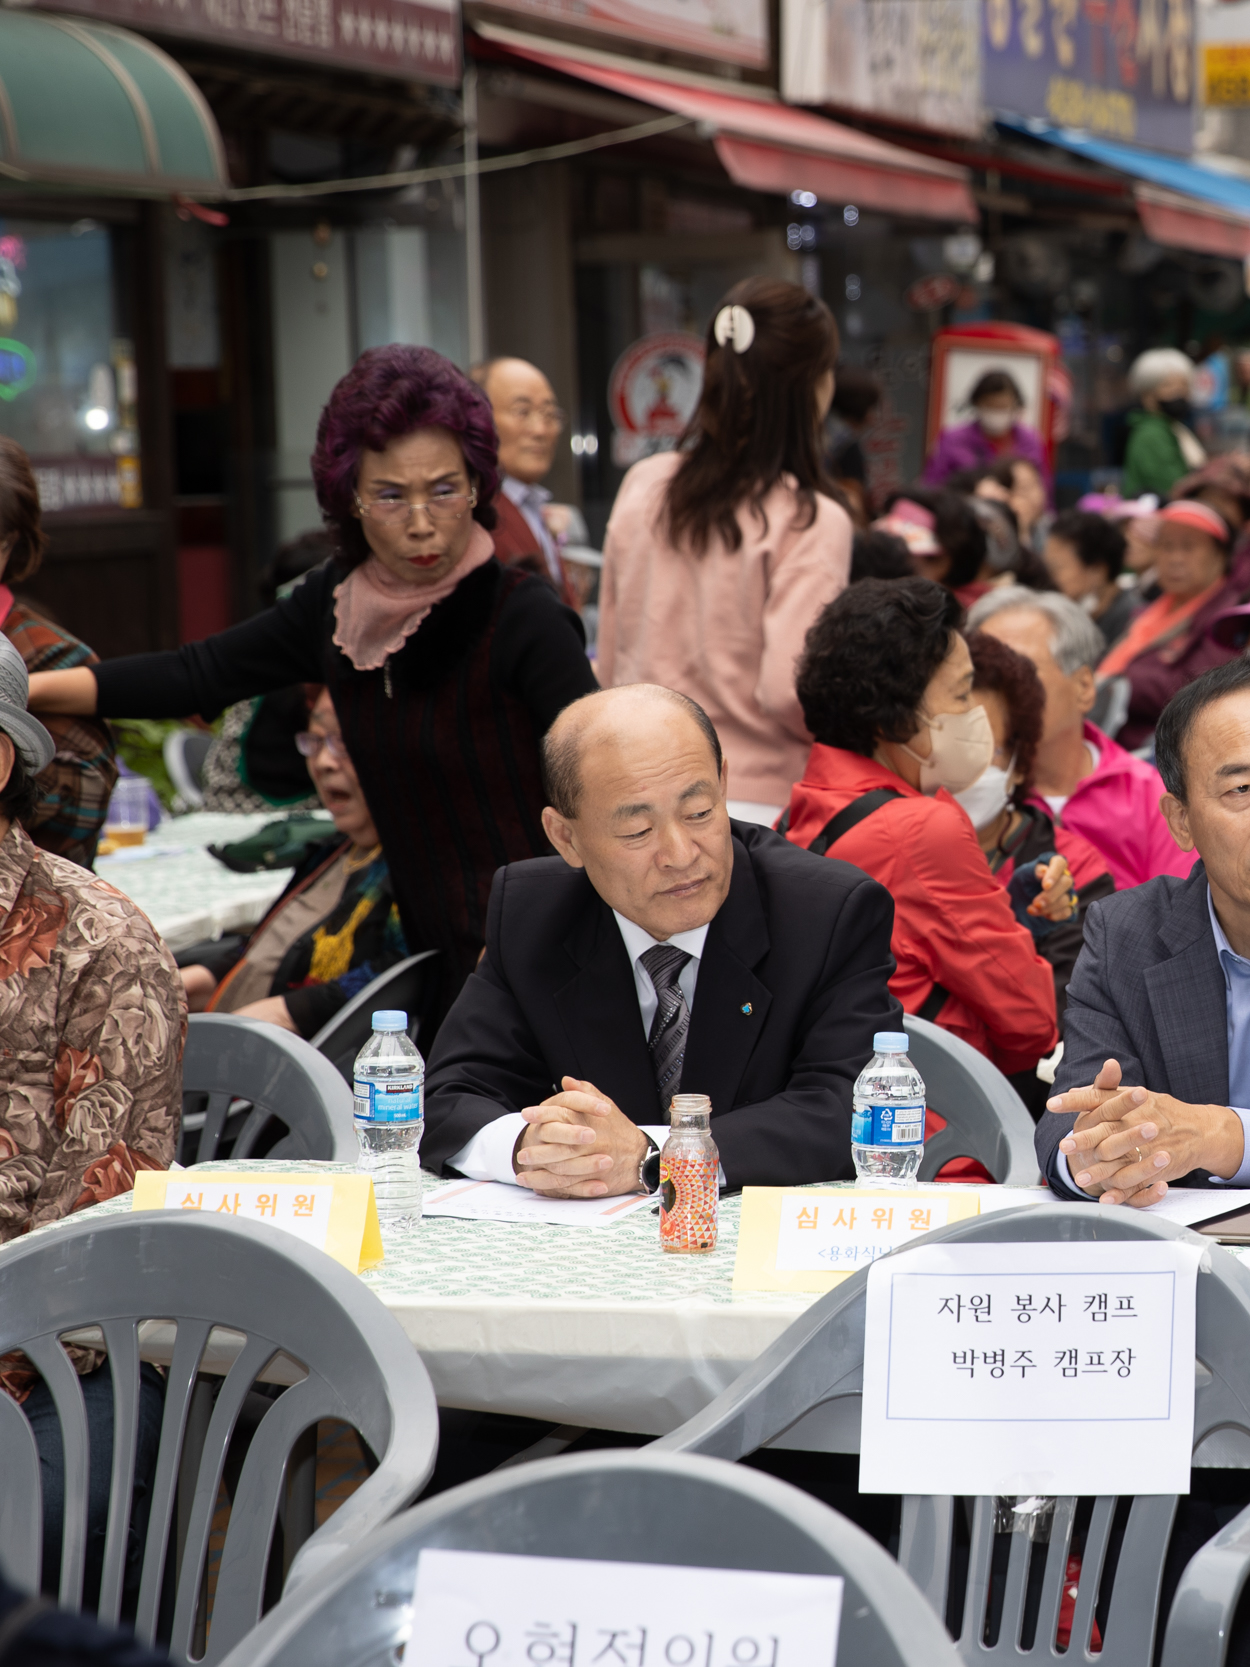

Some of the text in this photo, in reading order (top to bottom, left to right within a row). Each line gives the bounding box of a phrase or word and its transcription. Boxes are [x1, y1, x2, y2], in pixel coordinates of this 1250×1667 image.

[377, 1103, 402, 1111] mineral
[937, 1292, 1138, 1324] 자원 봉사 캠프
[951, 1347, 1137, 1379] 박병주 캠프장
